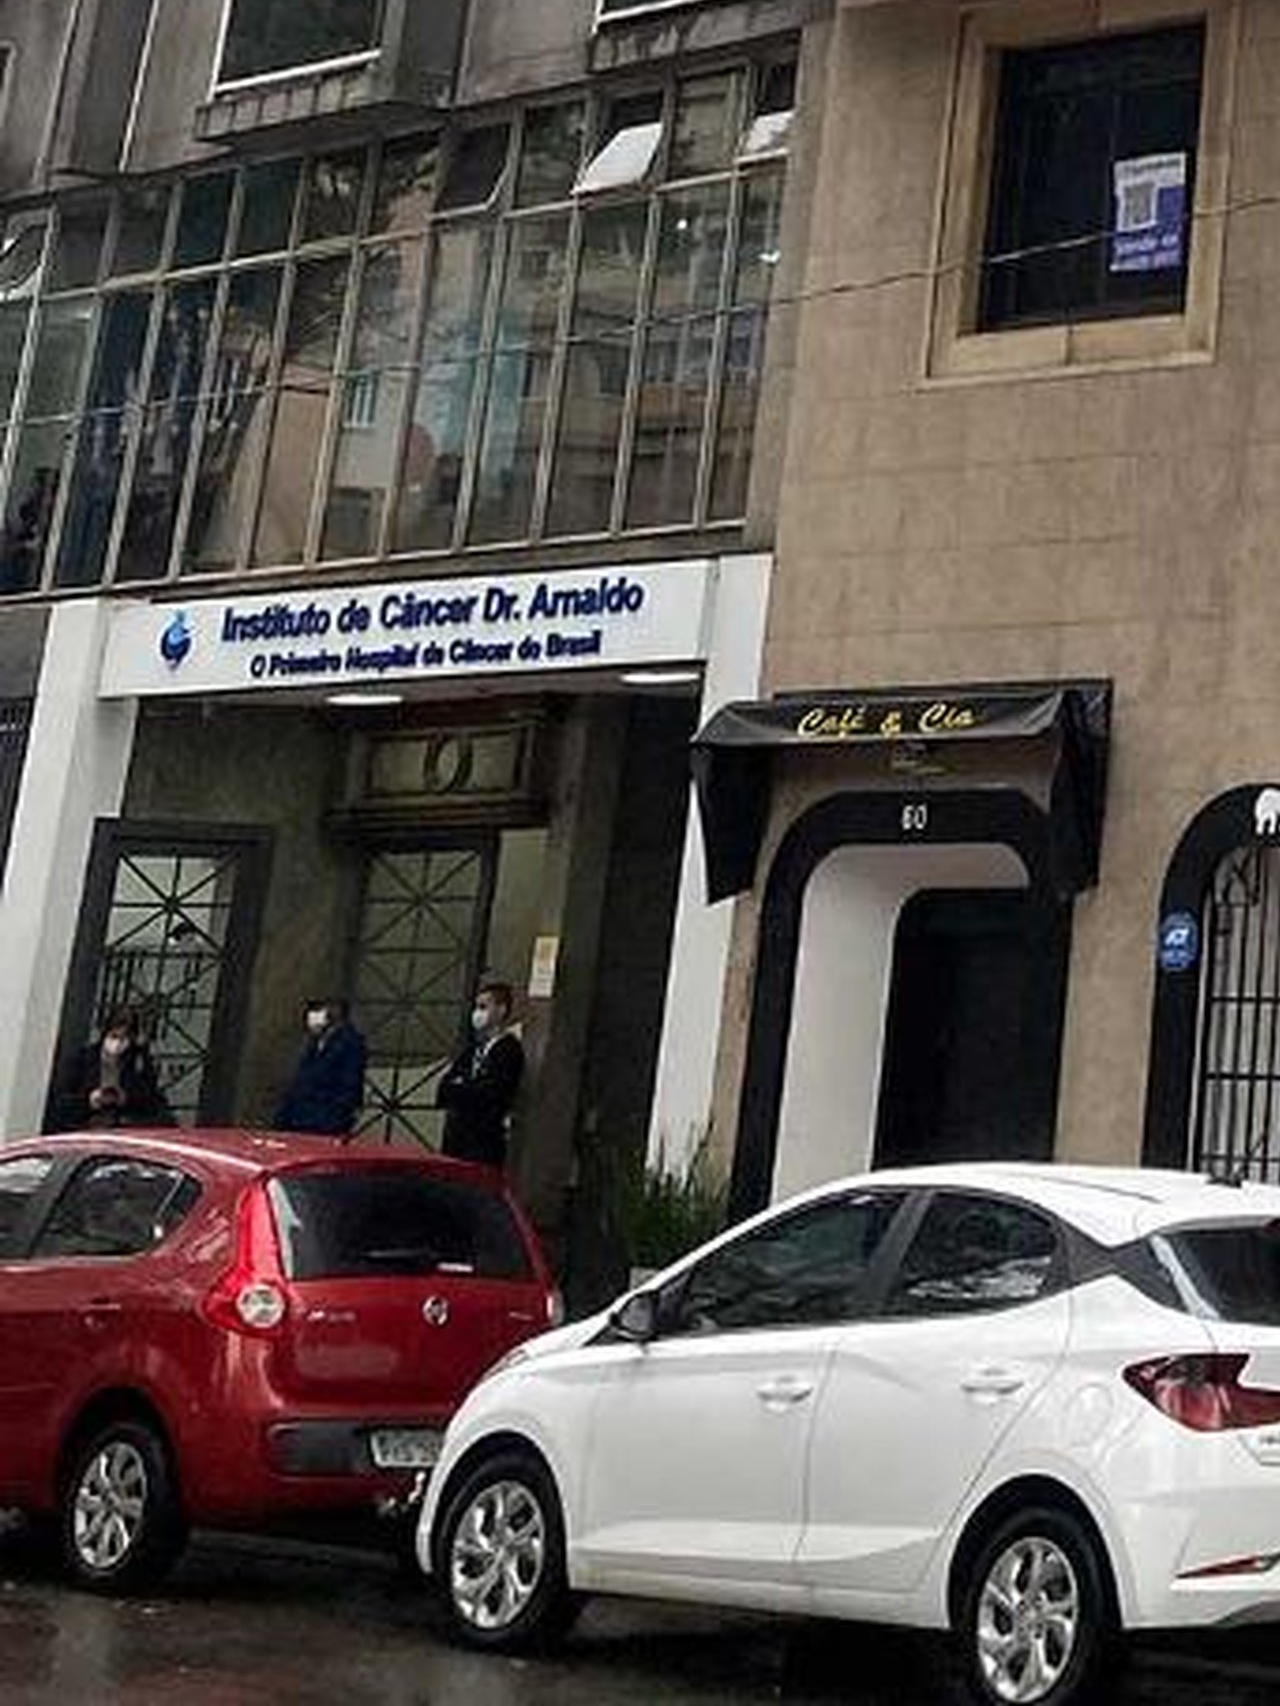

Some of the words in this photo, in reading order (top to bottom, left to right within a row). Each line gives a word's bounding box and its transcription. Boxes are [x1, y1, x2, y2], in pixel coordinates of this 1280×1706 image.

[221, 605, 331, 642] Instituto
[336, 600, 370, 633] de
[379, 592, 476, 629] Câncer
[482, 586, 521, 621] Dr.
[528, 577, 645, 619] Arnaldo
[250, 653, 266, 678] O
[345, 642, 418, 674] Hospital
[545, 629, 602, 656] Brasil
[797, 705, 868, 738] Café
